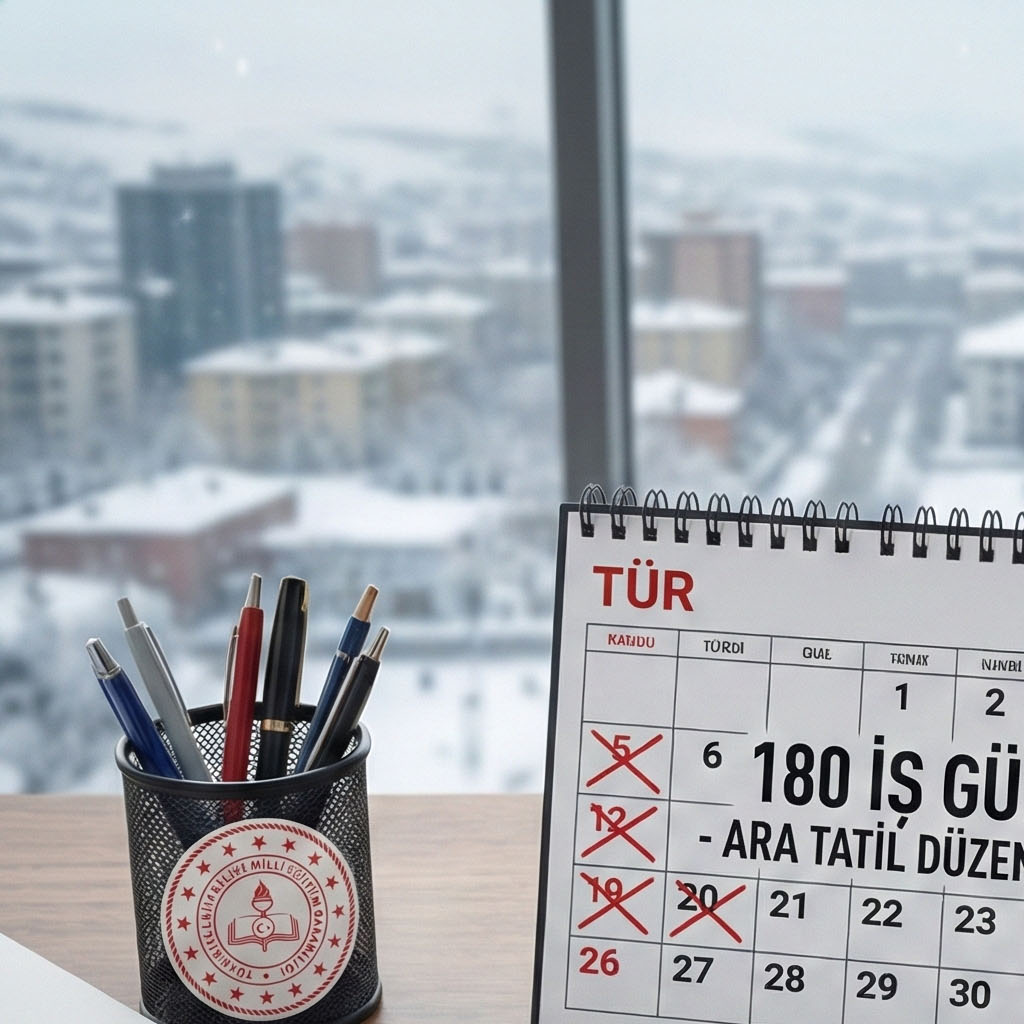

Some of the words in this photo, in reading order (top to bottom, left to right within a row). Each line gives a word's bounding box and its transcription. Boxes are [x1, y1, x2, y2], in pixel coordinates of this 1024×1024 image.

[593, 558, 694, 612] TÜR
[895, 682, 909, 710] 1
[985, 688, 1006, 717] 2
[612, 734, 631, 761] 5
[702, 741, 722, 769] 6
[753, 741, 851, 809] 180
[869, 734, 923, 828] İŞ
[592, 804, 627, 833] 12
[722, 819, 799, 864] ARA
[810, 821, 905, 873] TATİL
[587, 876, 623, 904] 19
[677, 882, 719, 913] 20
[769, 890, 807, 920] 21
[861, 897, 903, 928] 22
[954, 905, 997, 936] 23
[578, 946, 620, 977] 26
[672, 954, 714, 984] 27
[764, 962, 805, 993] 28
[856, 970, 898, 1001] 29
[949, 978, 991, 1009] 30
